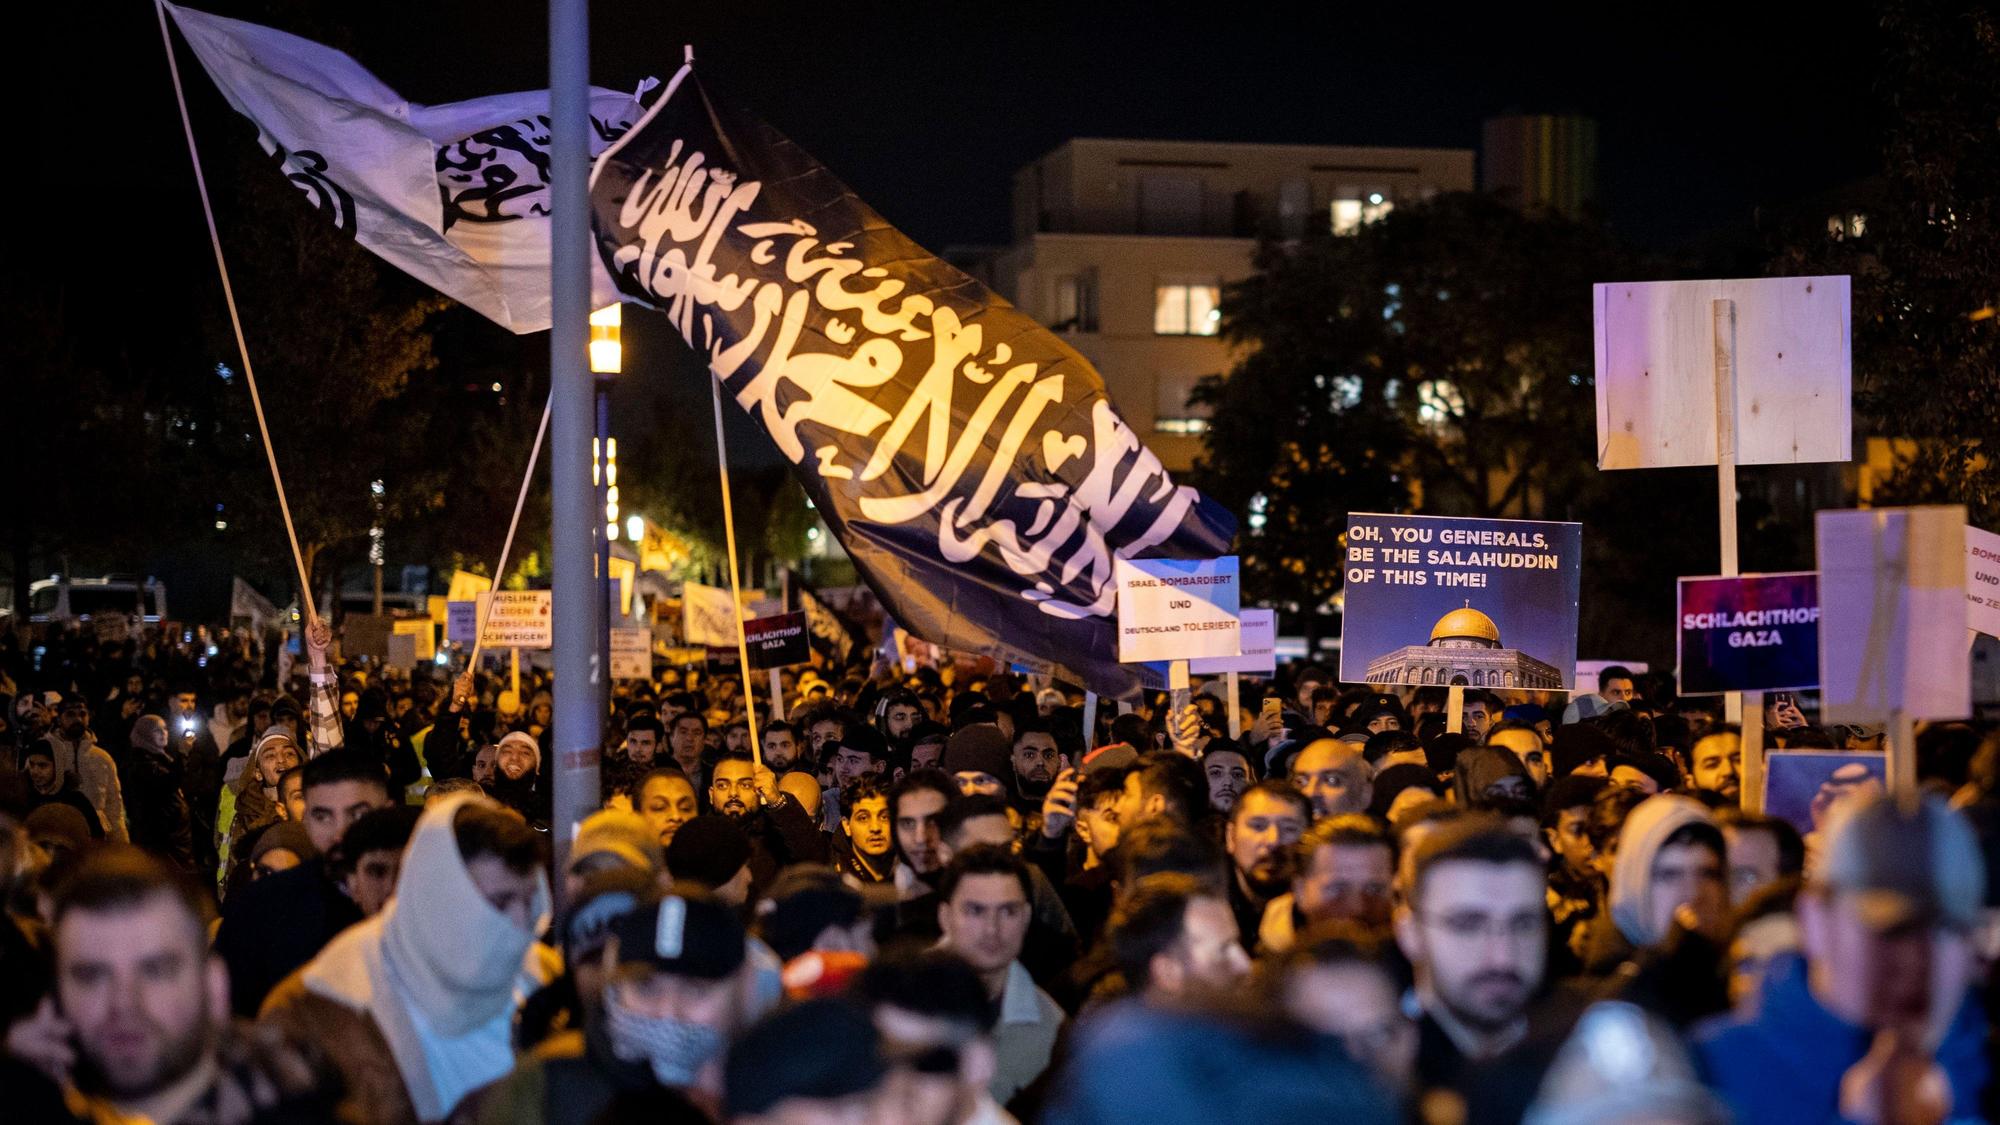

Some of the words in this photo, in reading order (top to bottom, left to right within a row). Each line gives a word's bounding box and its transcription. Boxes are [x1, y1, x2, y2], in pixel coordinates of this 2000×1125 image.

[1349, 525, 1384, 544] OH,
[1391, 527, 1432, 544] YOU
[1440, 529, 1549, 550] GENERALS,
[1349, 547, 1374, 562] BE
[1382, 548, 1420, 564] THE
[1427, 549, 1558, 570] SALAHUDDIN
[1128, 579, 1157, 588] ISRAEL
[1160, 575, 1231, 587] BOMBARDIERT
[1348, 568, 1375, 583] OF
[1382, 569, 1427, 586] THIS
[1434, 571, 1487, 588] TIME!
[1975, 571, 1999, 586] UND
[1169, 600, 1192, 609] UND
[1683, 606, 1820, 630] SCHLACHTHOF
[746, 626, 802, 643] CHLACHTHOF
[1125, 625, 1181, 635] DEUTSCHLAND
[1183, 621, 1236, 632] TOLERIERT
[1728, 630, 1782, 648] GAZA
